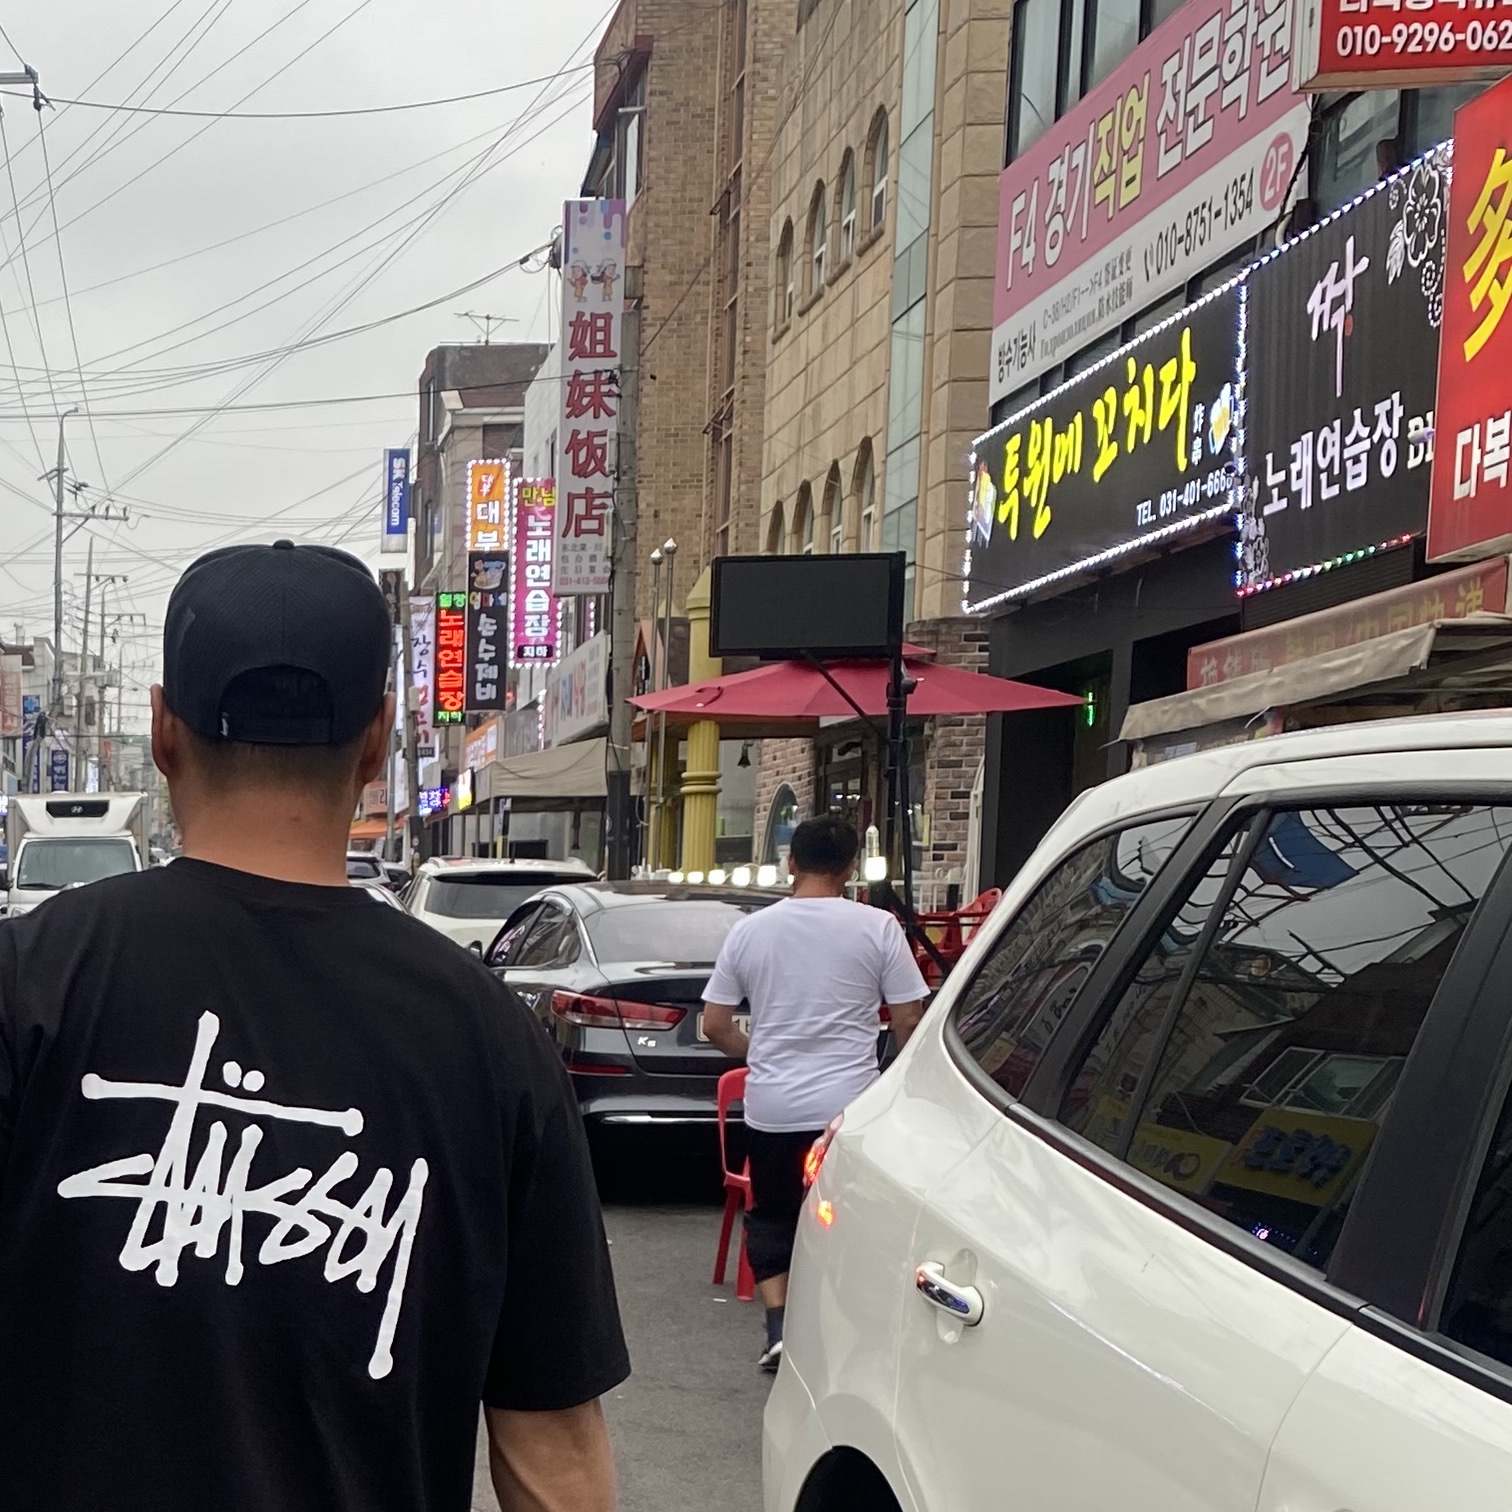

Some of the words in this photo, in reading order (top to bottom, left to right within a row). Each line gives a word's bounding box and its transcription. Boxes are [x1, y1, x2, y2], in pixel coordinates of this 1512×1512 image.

[1264, 144, 1290, 203] 2F
[1007, 177, 1039, 292] F4
[1155, 166, 1256, 276] 010-8751-1354
[391, 456, 406, 480] SK
[561, 310, 618, 538] 姐妹饭店
[1263, 391, 1405, 516] 노래연습장
[390, 481, 405, 527] Telecom
[475, 500, 502, 552] 대부
[1136, 498, 1157, 526] TEL.
[524, 514, 552, 638] 노래연습장
[438, 609, 465, 711] 노래연습장
[476, 613, 499, 701] 손수제비
[523, 645, 549, 658] 지하
